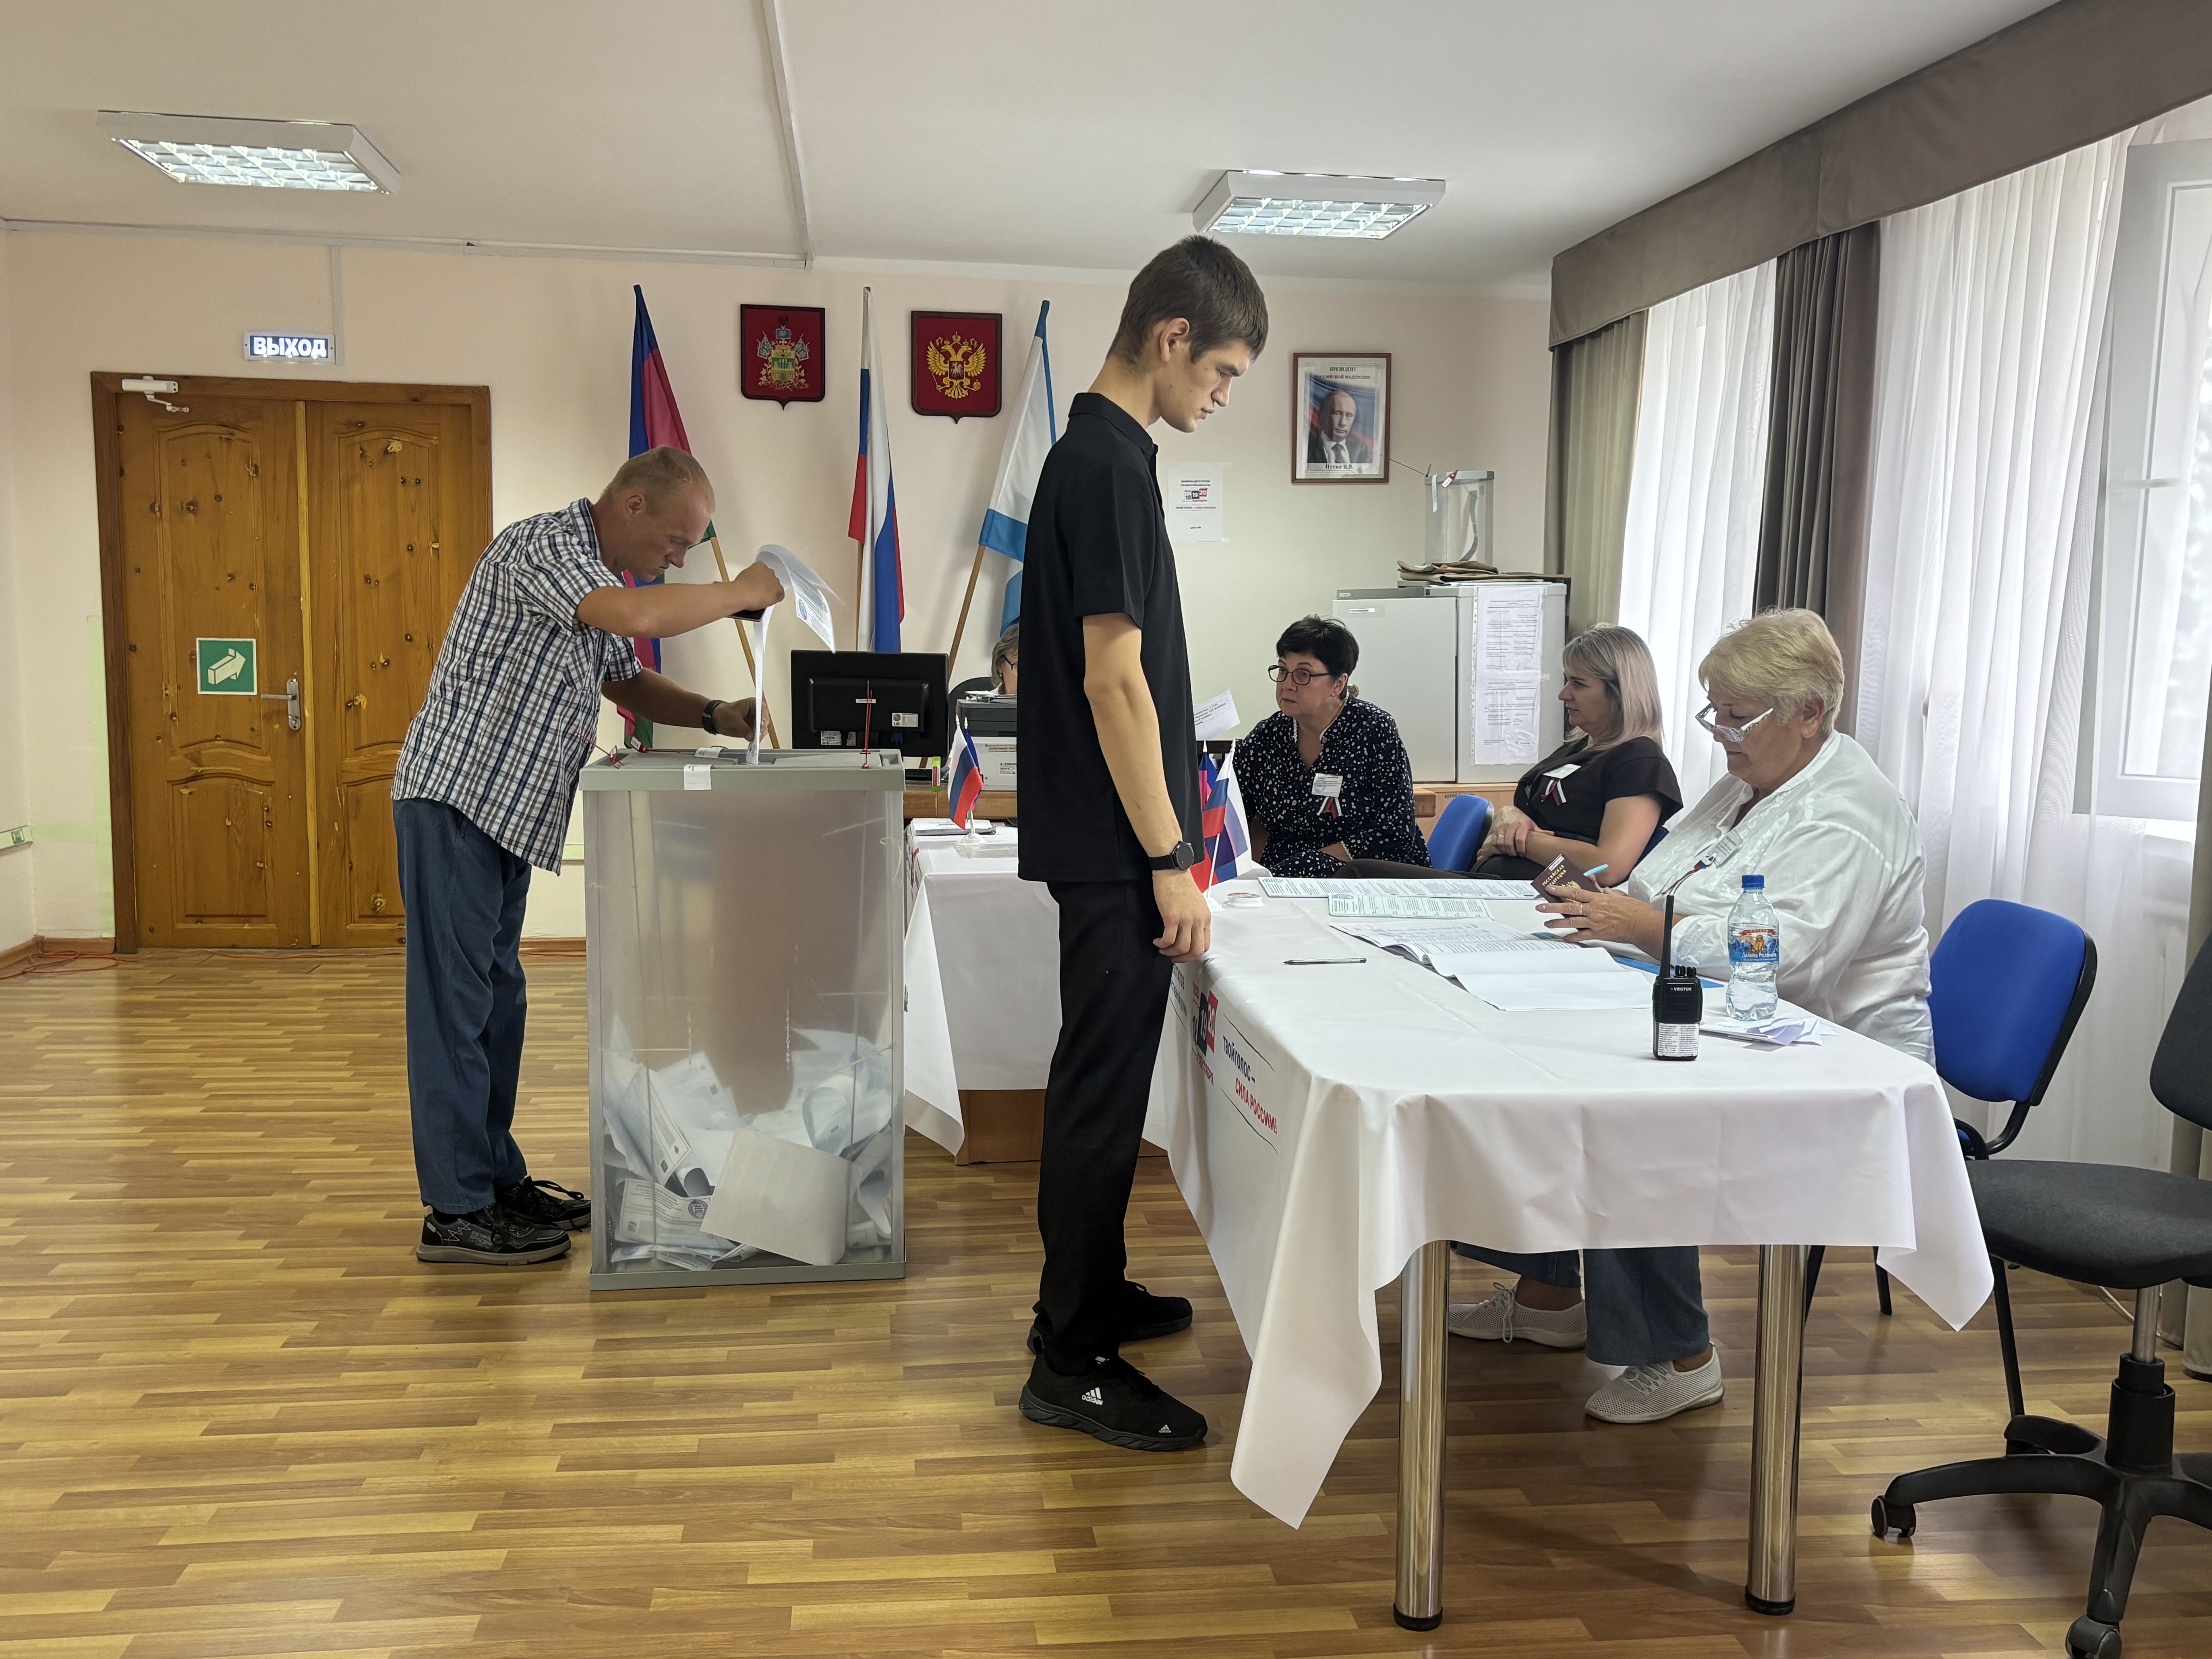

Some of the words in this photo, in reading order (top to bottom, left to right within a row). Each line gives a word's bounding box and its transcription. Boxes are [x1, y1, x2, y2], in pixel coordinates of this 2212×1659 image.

[254, 337, 326, 357] ВЫХОД
[1200, 1008, 1207, 1041] 19
[1208, 1003, 1215, 1038] 20
[1223, 1035, 1235, 1062] ТВОЙ
[1235, 1050, 1251, 1082] ГОЛОС
[1235, 1077, 1249, 1106] СИЛА
[1250, 1093, 1277, 1135] РОССИИ!
[1082, 1395, 1103, 1405] adidas
